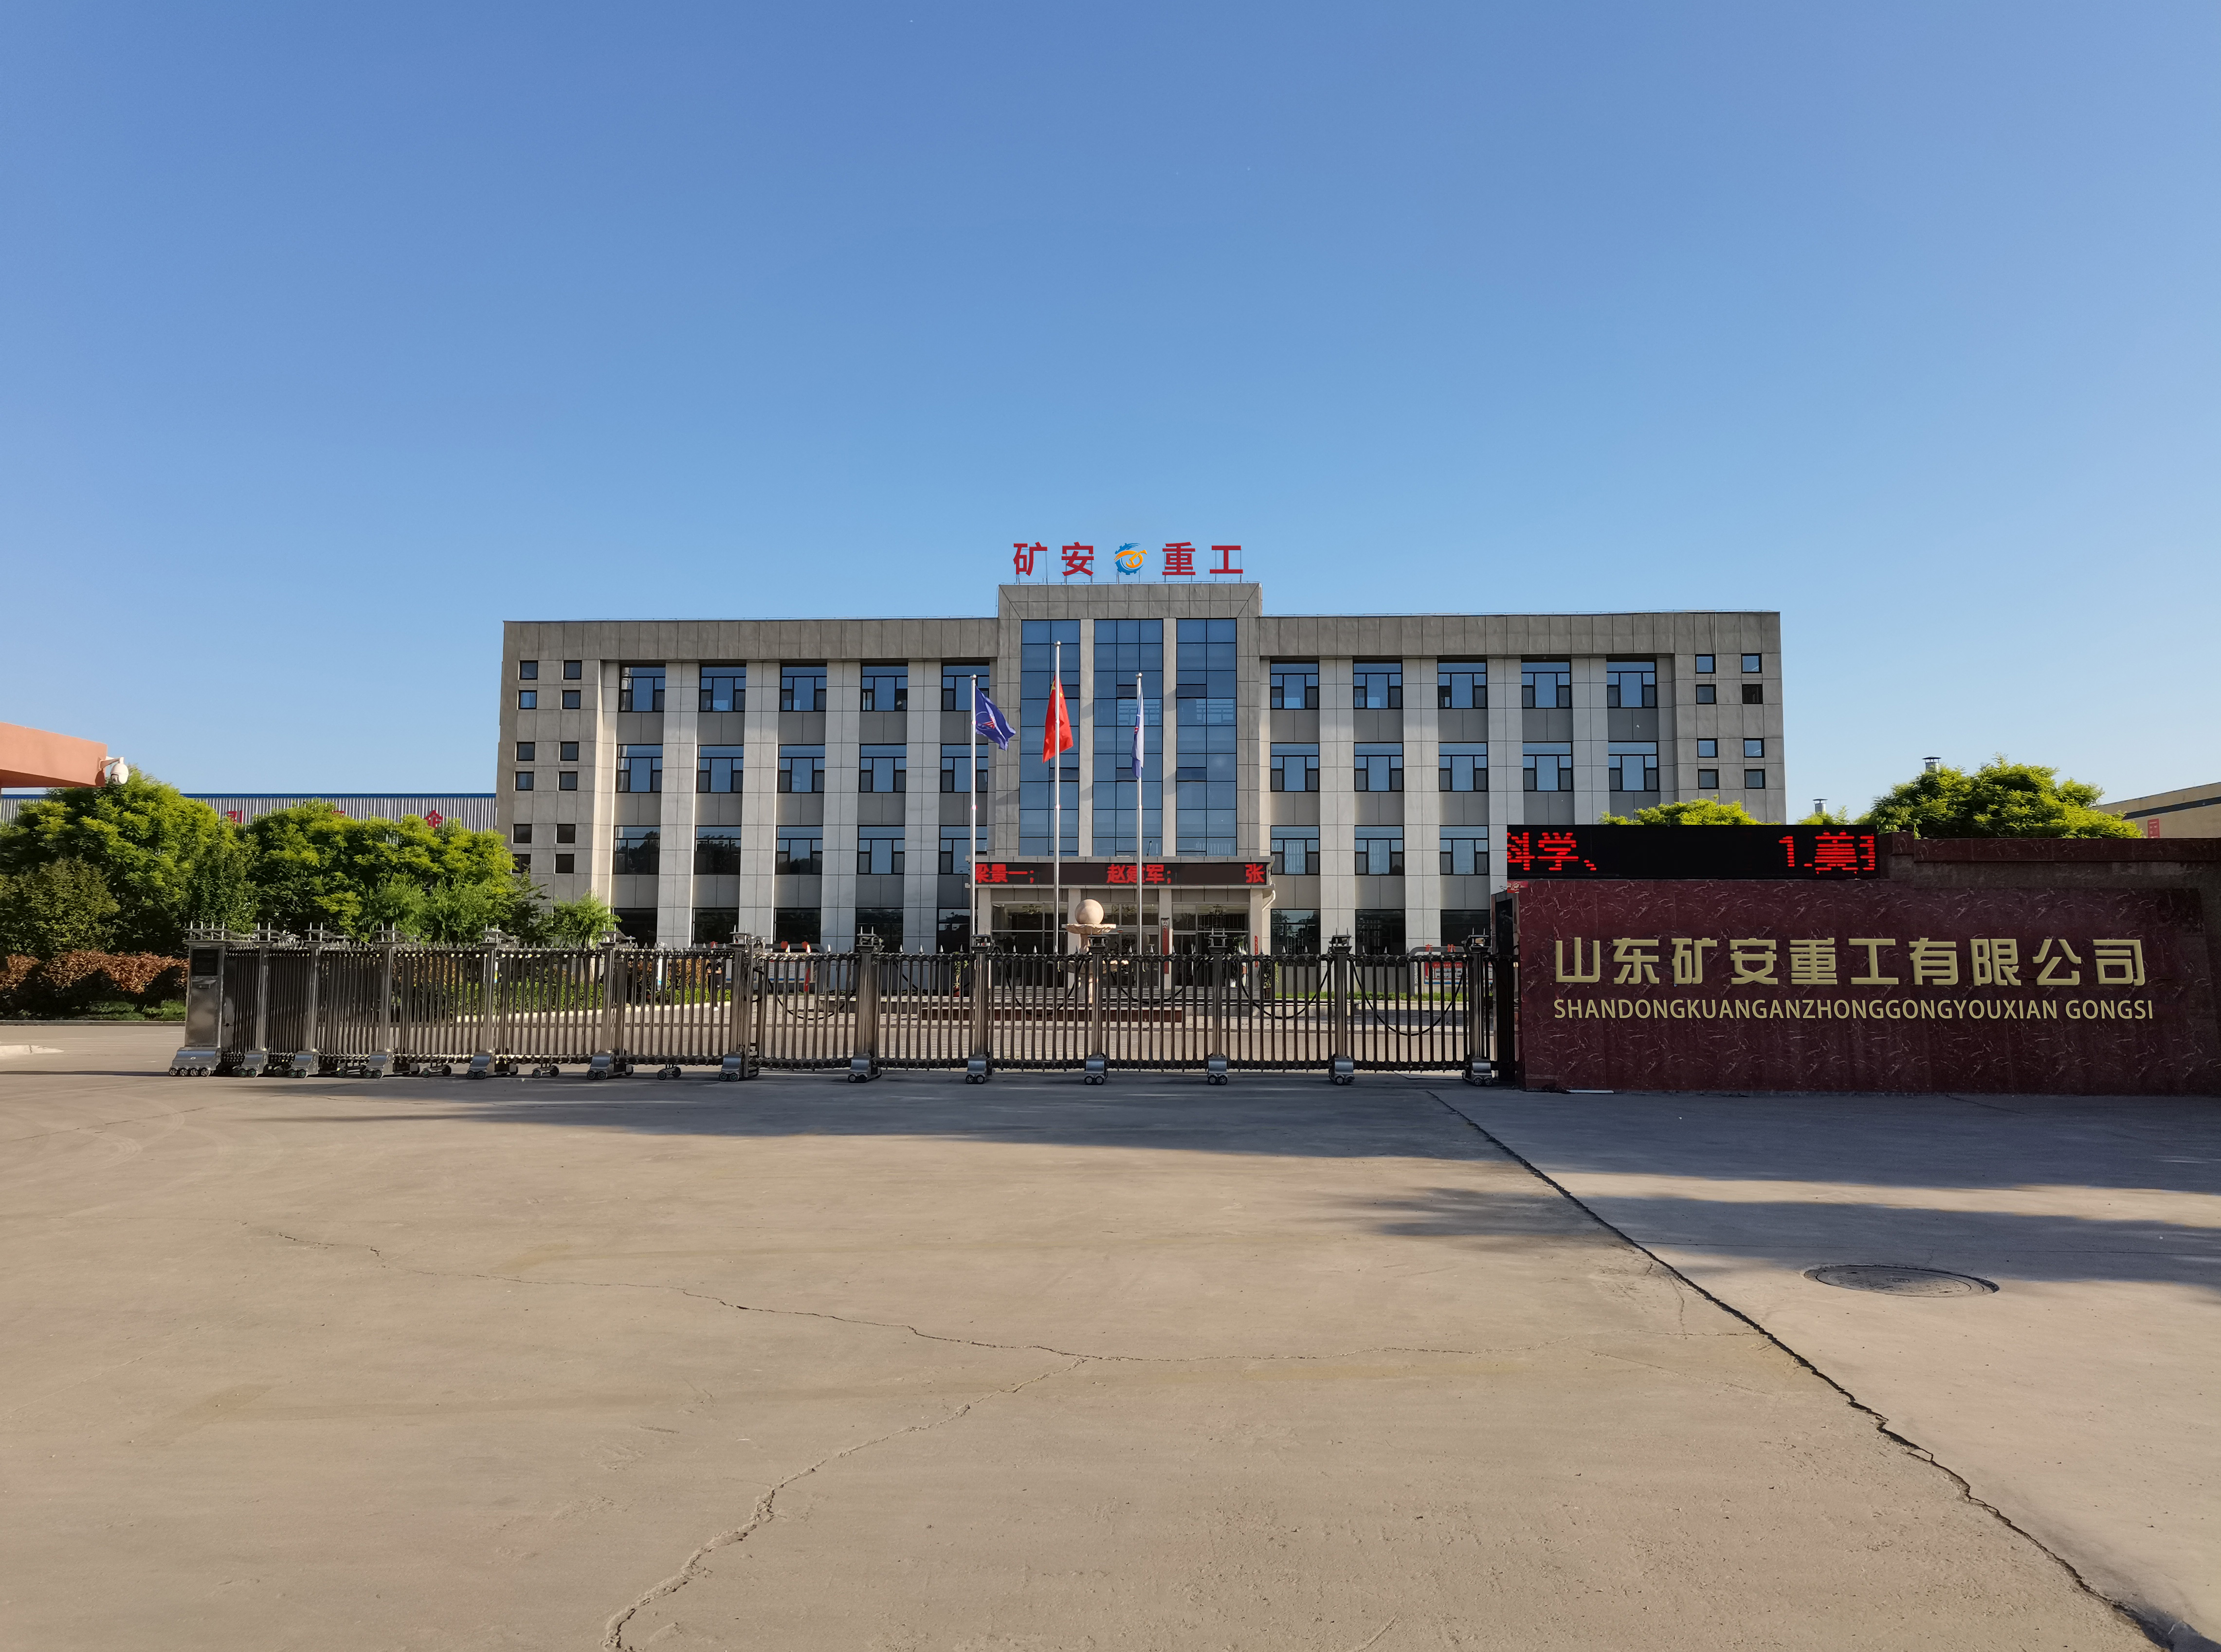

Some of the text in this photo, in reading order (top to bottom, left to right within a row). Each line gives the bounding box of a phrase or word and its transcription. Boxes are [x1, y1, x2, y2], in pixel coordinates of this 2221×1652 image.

[1013, 542, 1244, 577] 矿安 重工
[1245, 863, 1265, 883] 张
[1555, 936, 2146, 986] 山东矿安重工有限公司
[1553, 998, 2153, 1020] SHANDONGKUANGANZHONGGONGYOUXIAN GONGSI
